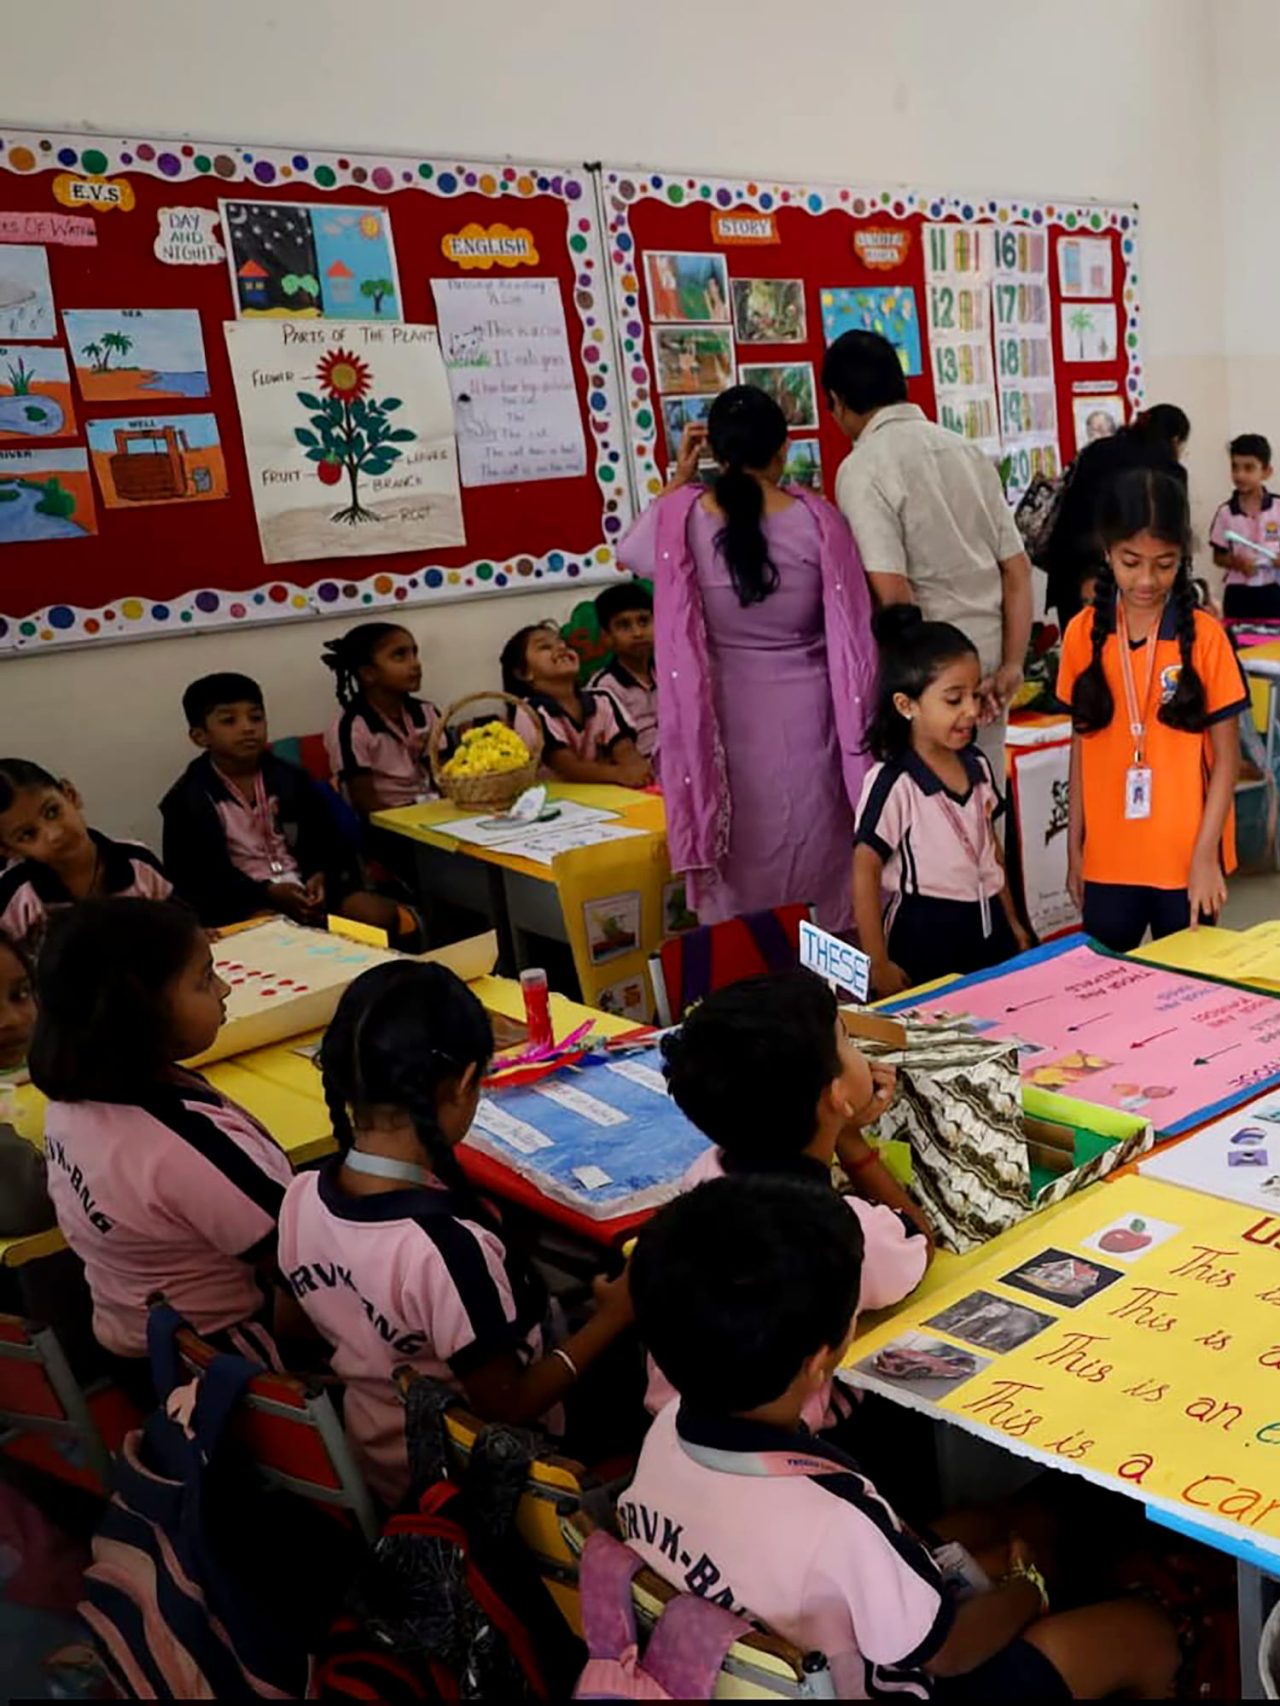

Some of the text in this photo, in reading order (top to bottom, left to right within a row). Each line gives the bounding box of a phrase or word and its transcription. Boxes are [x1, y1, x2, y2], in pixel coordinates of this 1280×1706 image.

[72, 184, 119, 202] E.V.S
[169, 213, 200, 229] DAY
[170, 230, 204, 243] AND
[721, 220, 768, 235] STORY
[452, 238, 527, 256] ENGLISH
[994, 229, 1017, 269] 16
[932, 287, 955, 328] 12
[996, 284, 1017, 323] 17
[282, 322, 437, 345] PARTS OF THE PLANT
[936, 346, 959, 384] 13
[999, 339, 1019, 376] 18
[252, 369, 294, 387] FLOWER
[128, 420, 156, 428] WELL
[1002, 391, 1021, 432] 19
[261, 470, 300, 487] FRUIT
[803, 927, 866, 993] THESE
[1169, 1245, 1238, 1289] This
[1107, 1286, 1178, 1332] This
[1195, 1329, 1230, 1353] is
[1034, 1332, 1113, 1383] This
[1122, 1377, 1167, 1404] is
[1185, 1395, 1244, 1433] an
[961, 1380, 1043, 1438] This
[1046, 1429, 1094, 1461] is
[1117, 1451, 1158, 1484] a
